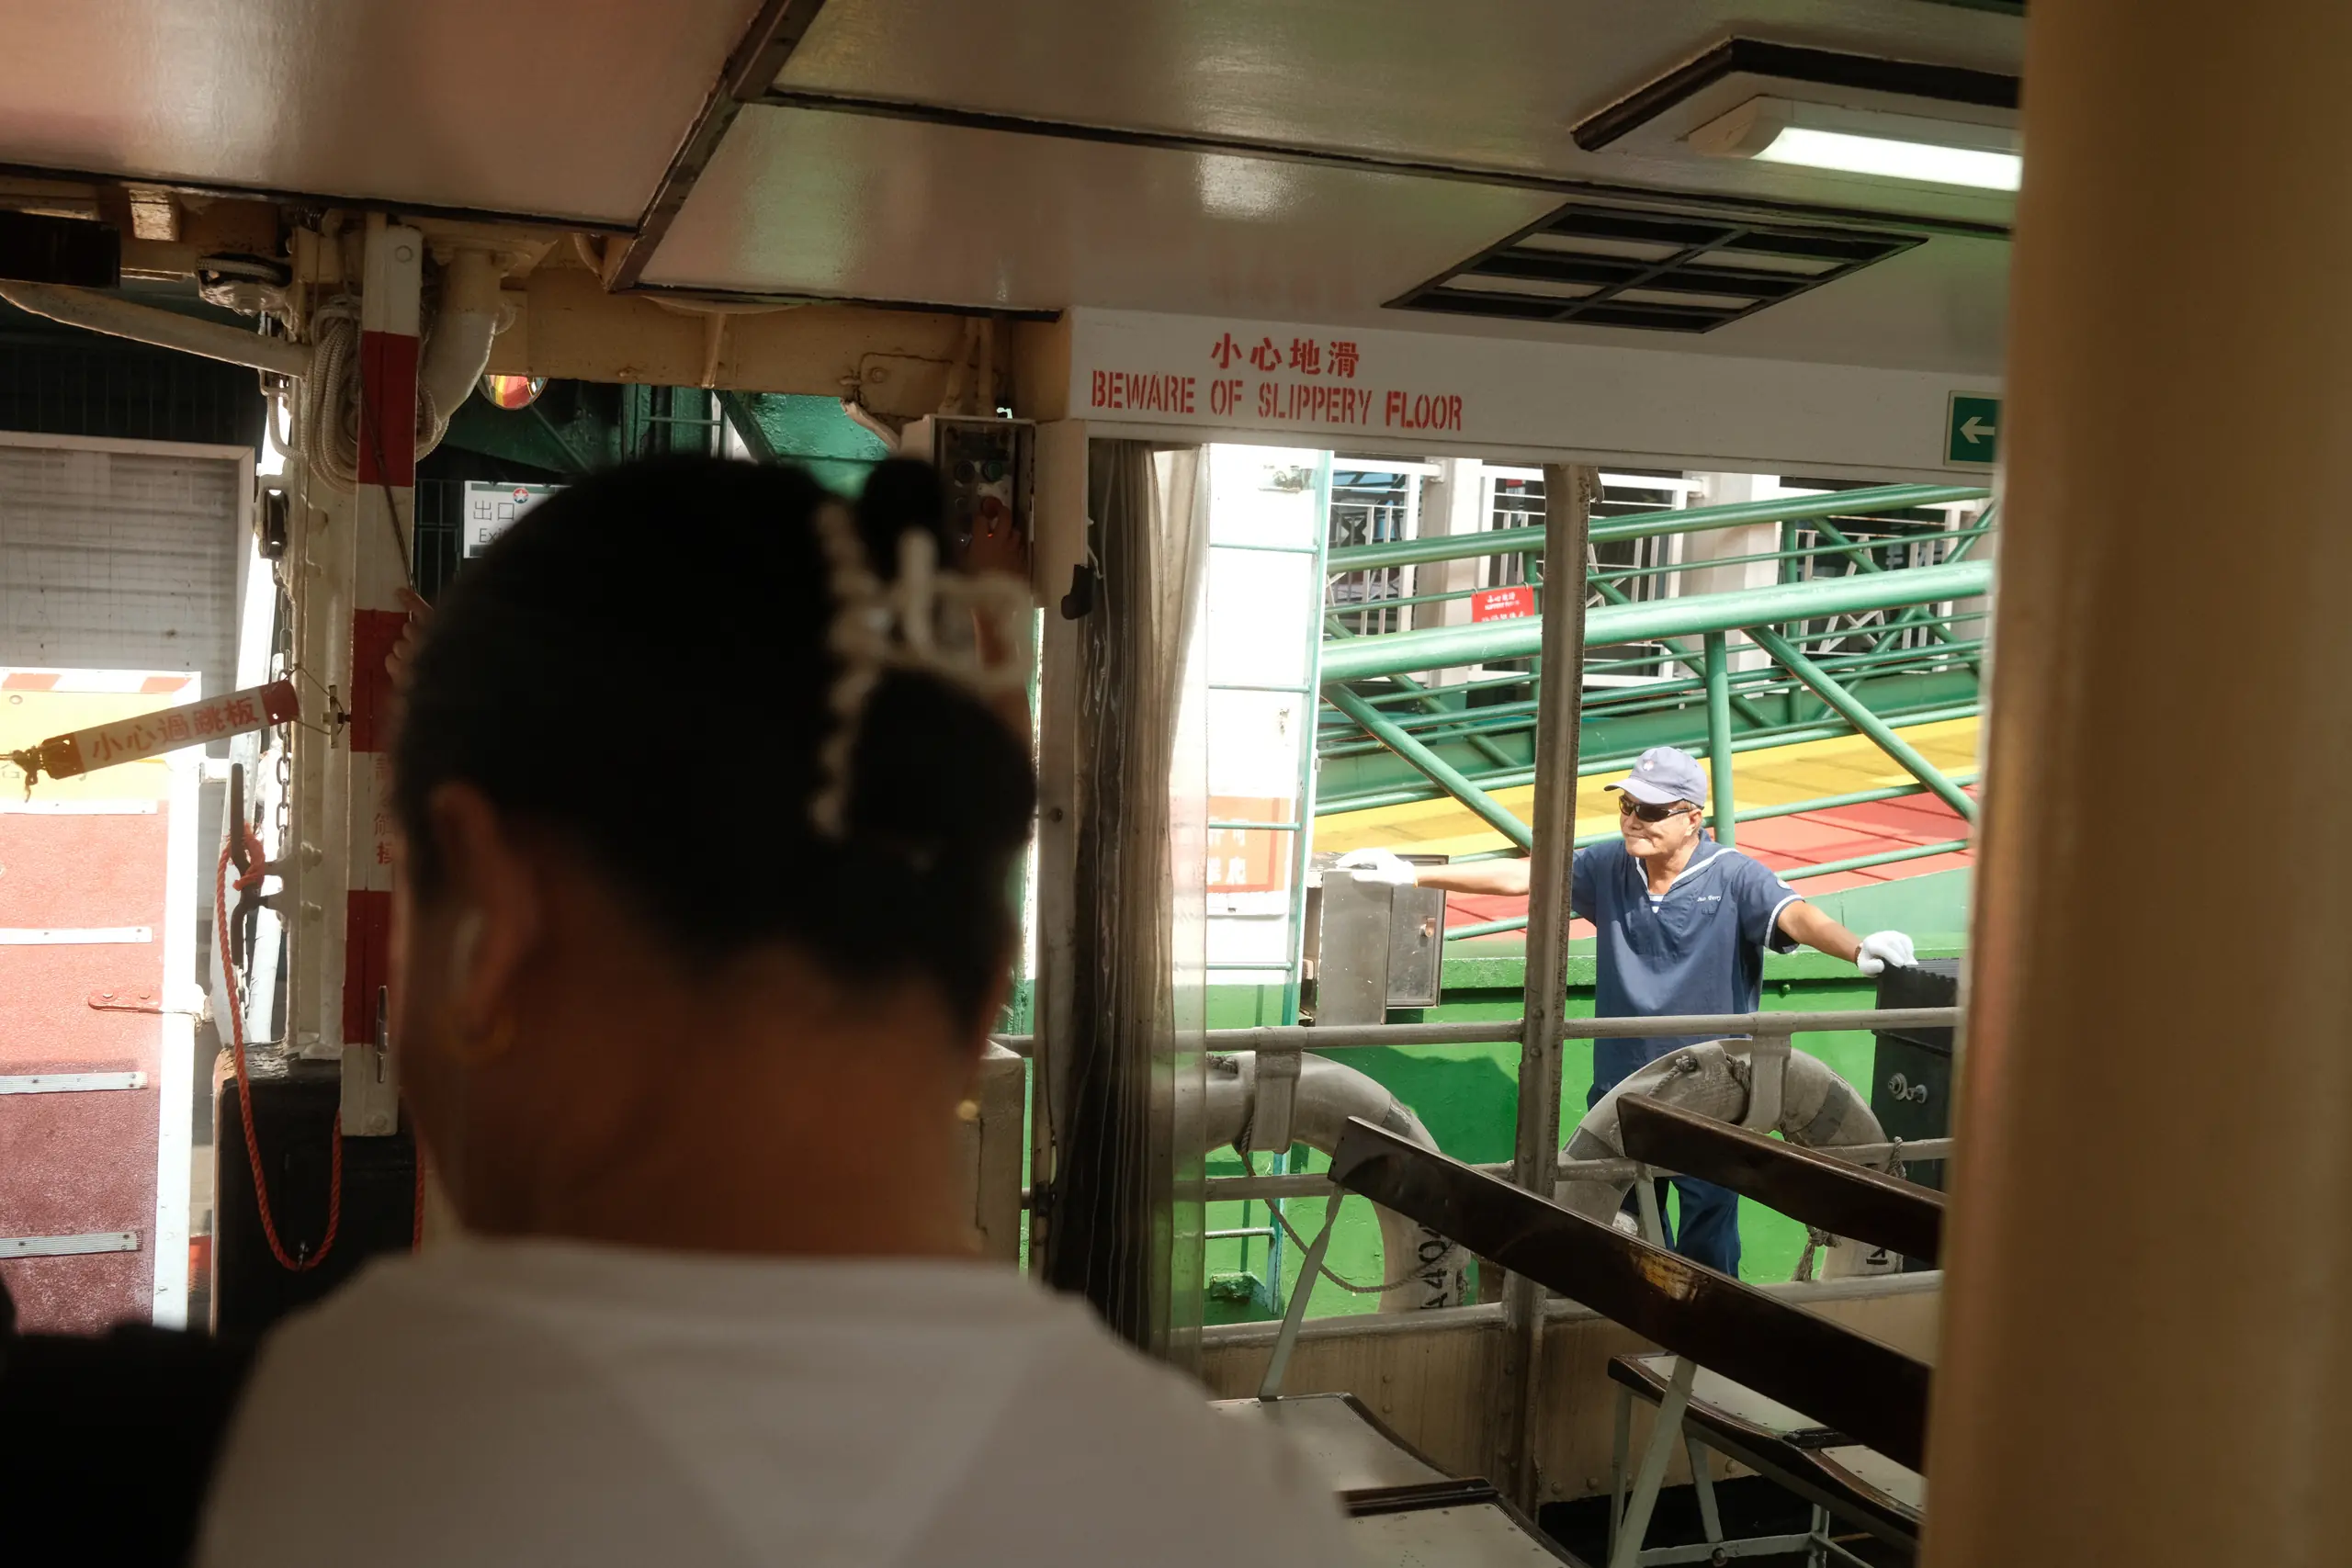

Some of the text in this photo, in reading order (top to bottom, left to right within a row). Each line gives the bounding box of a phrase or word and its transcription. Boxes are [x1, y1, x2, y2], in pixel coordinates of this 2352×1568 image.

[1211, 333, 1360, 378] 小心地滑
[1091, 370, 1463, 431] BEWARE OF SLIPPERY FLOOR
[473, 500, 514, 521] 出口
[92, 696, 261, 761] 小心過跳板
